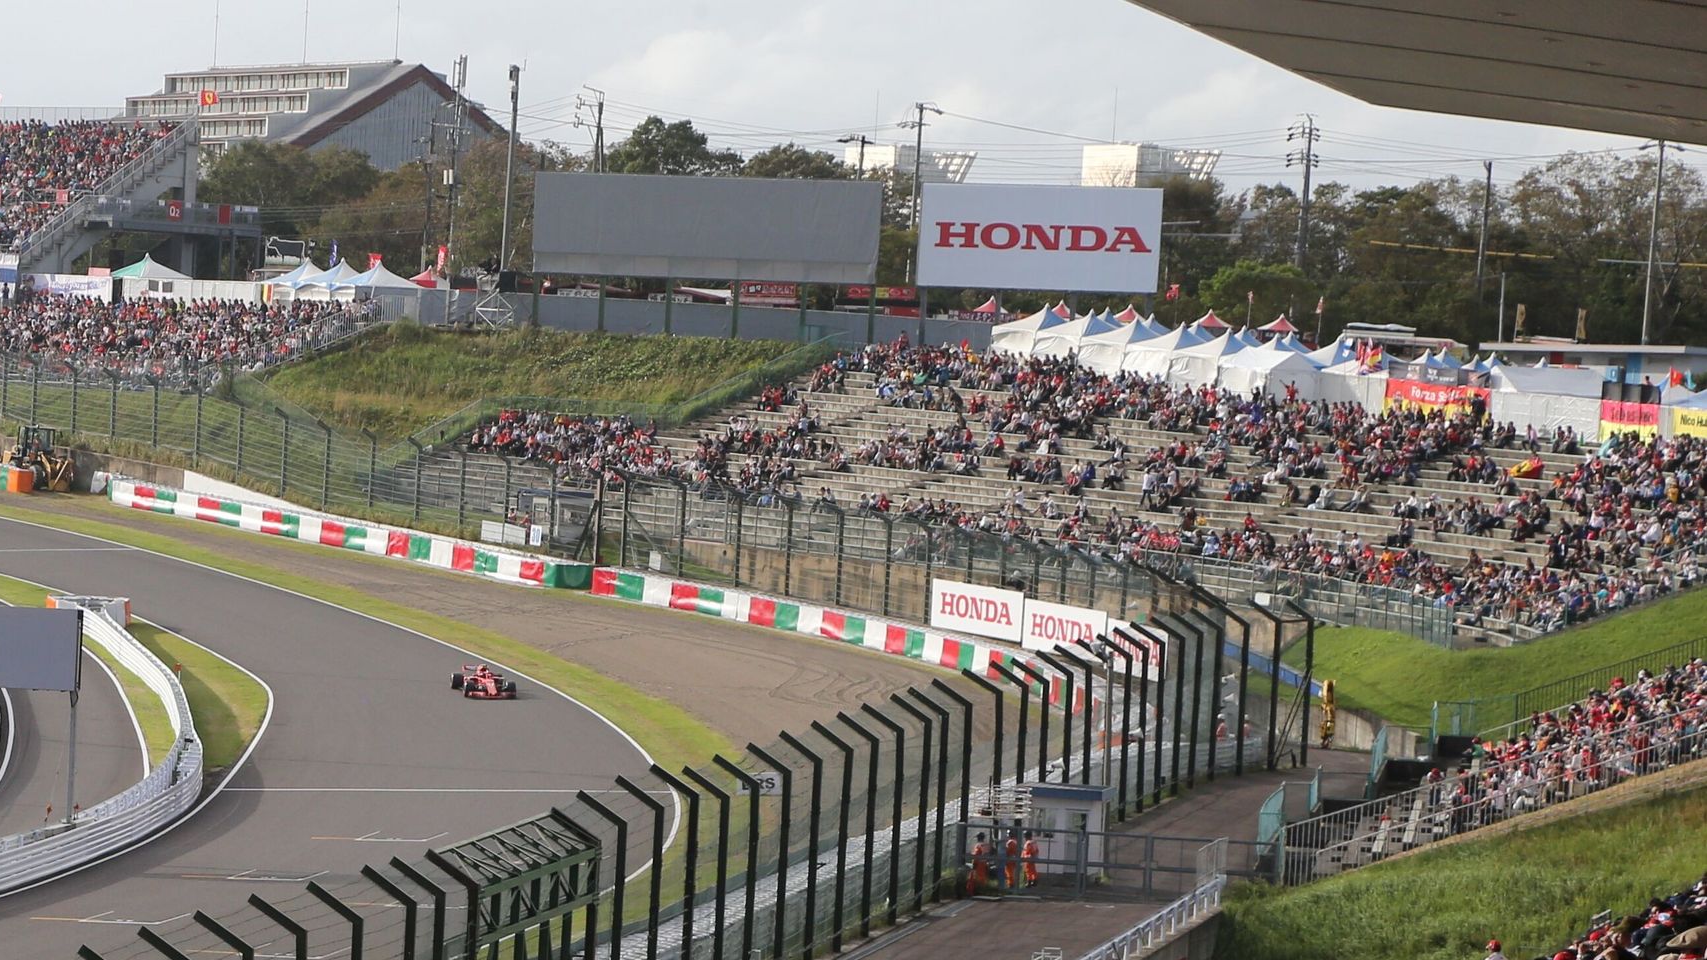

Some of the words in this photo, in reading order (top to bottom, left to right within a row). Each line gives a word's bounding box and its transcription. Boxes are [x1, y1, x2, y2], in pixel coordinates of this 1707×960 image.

[934, 222, 1152, 253] HONDA
[940, 592, 1013, 626] HONDA
[1030, 613, 1094, 643] HONDA
